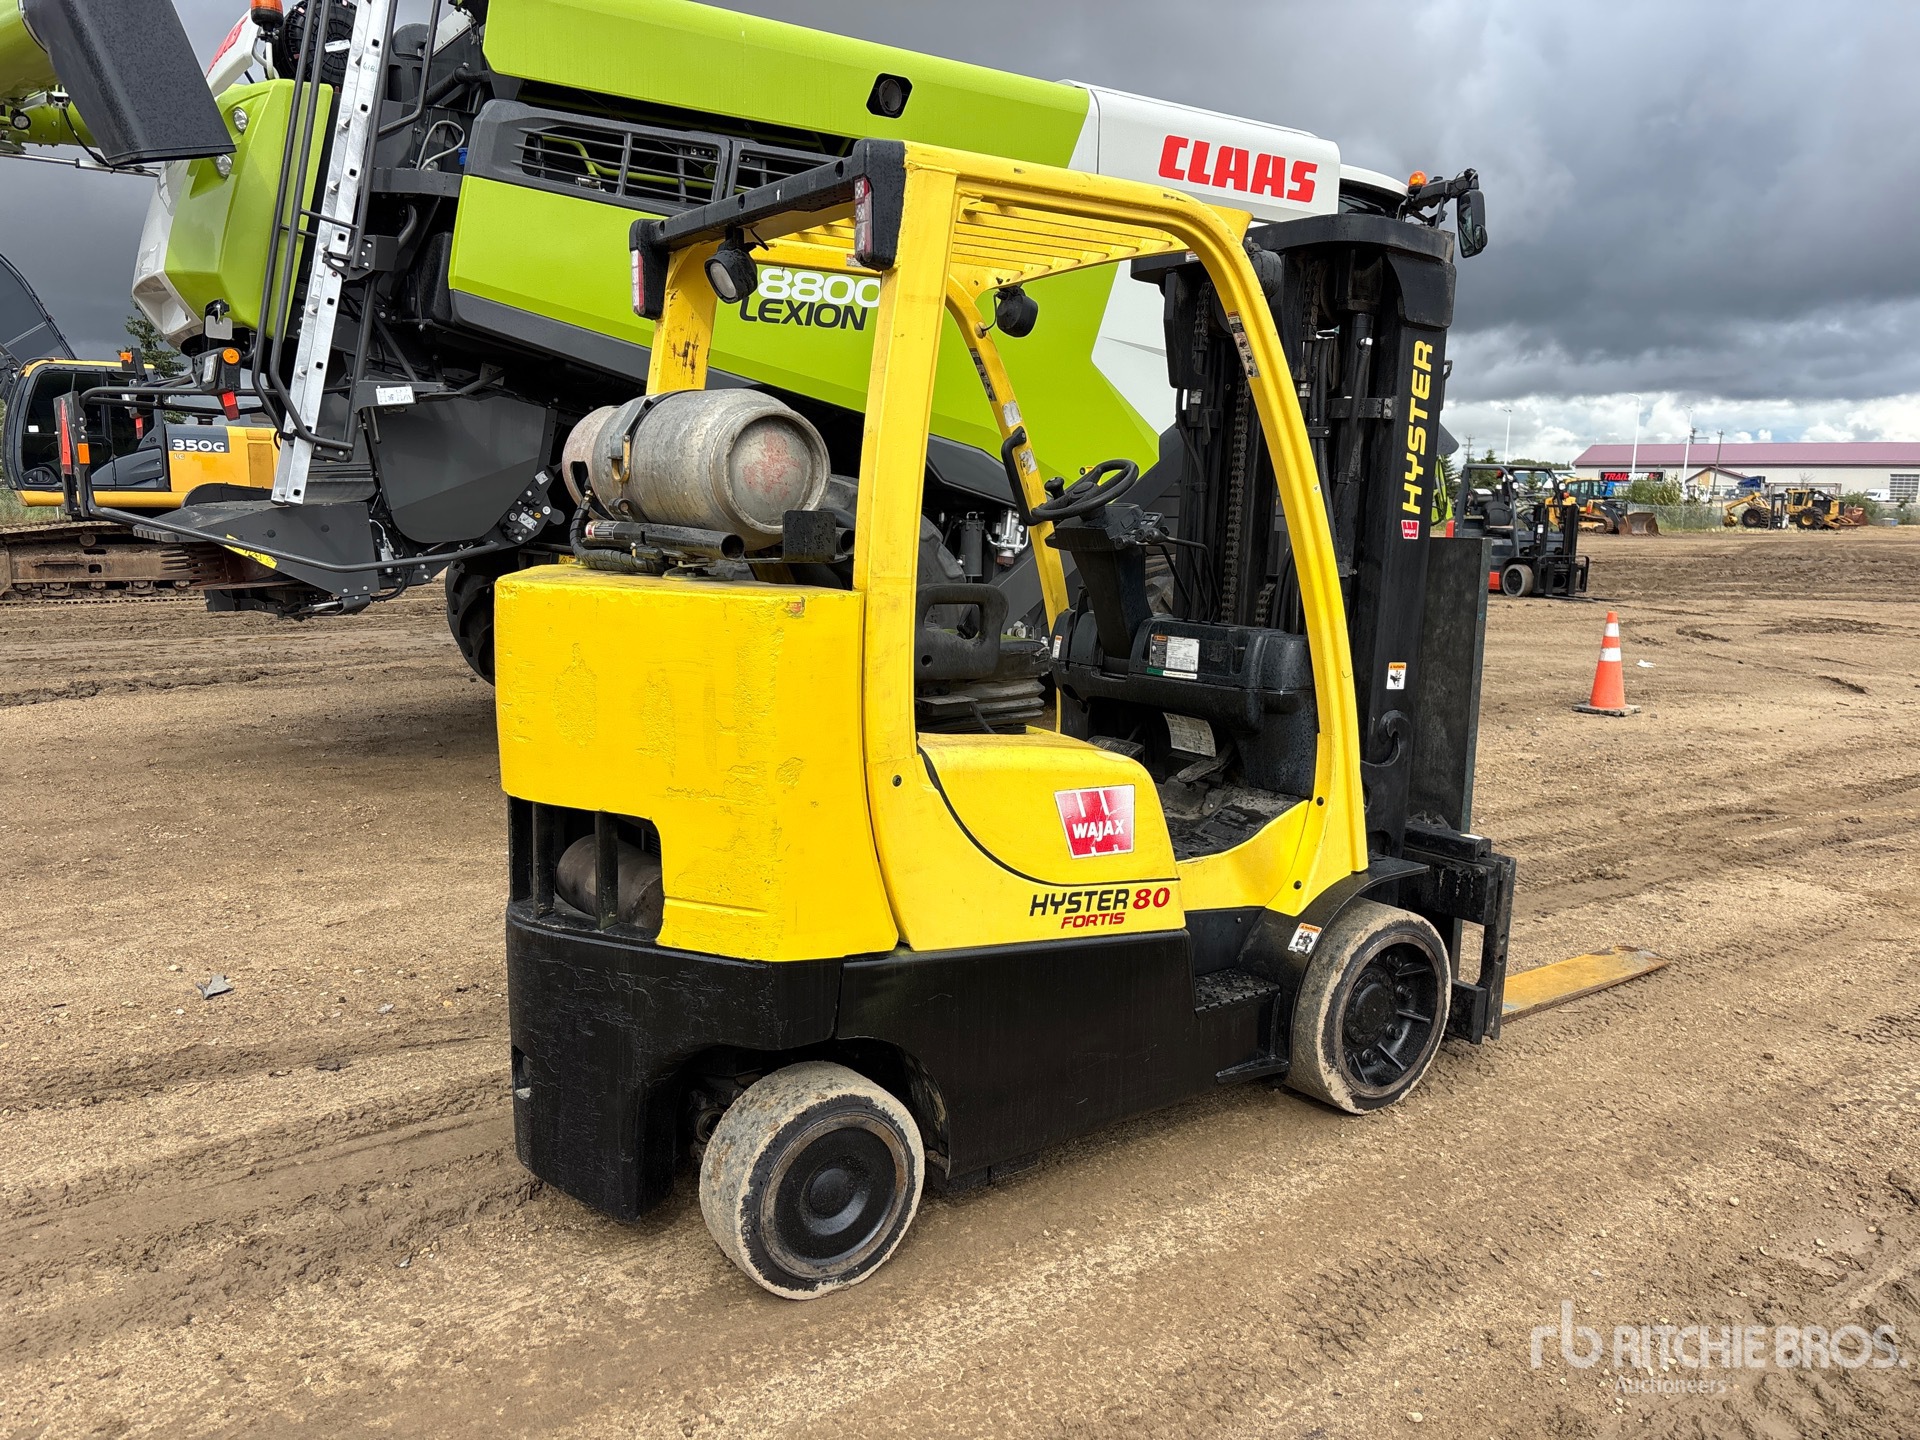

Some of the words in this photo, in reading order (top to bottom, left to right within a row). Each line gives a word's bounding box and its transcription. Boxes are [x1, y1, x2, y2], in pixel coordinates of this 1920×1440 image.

[1158, 134, 1318, 203] CLAAS
[757, 268, 881, 308] 8800
[739, 297, 868, 331] LEXION
[1402, 340, 1433, 515] HYSTER
[172, 438, 225, 452] 350G
[1072, 819, 1125, 842] WAJAX
[1029, 888, 1130, 917] HYSTER
[1132, 887, 1170, 910] 80
[1060, 912, 1126, 929] FORTIS
